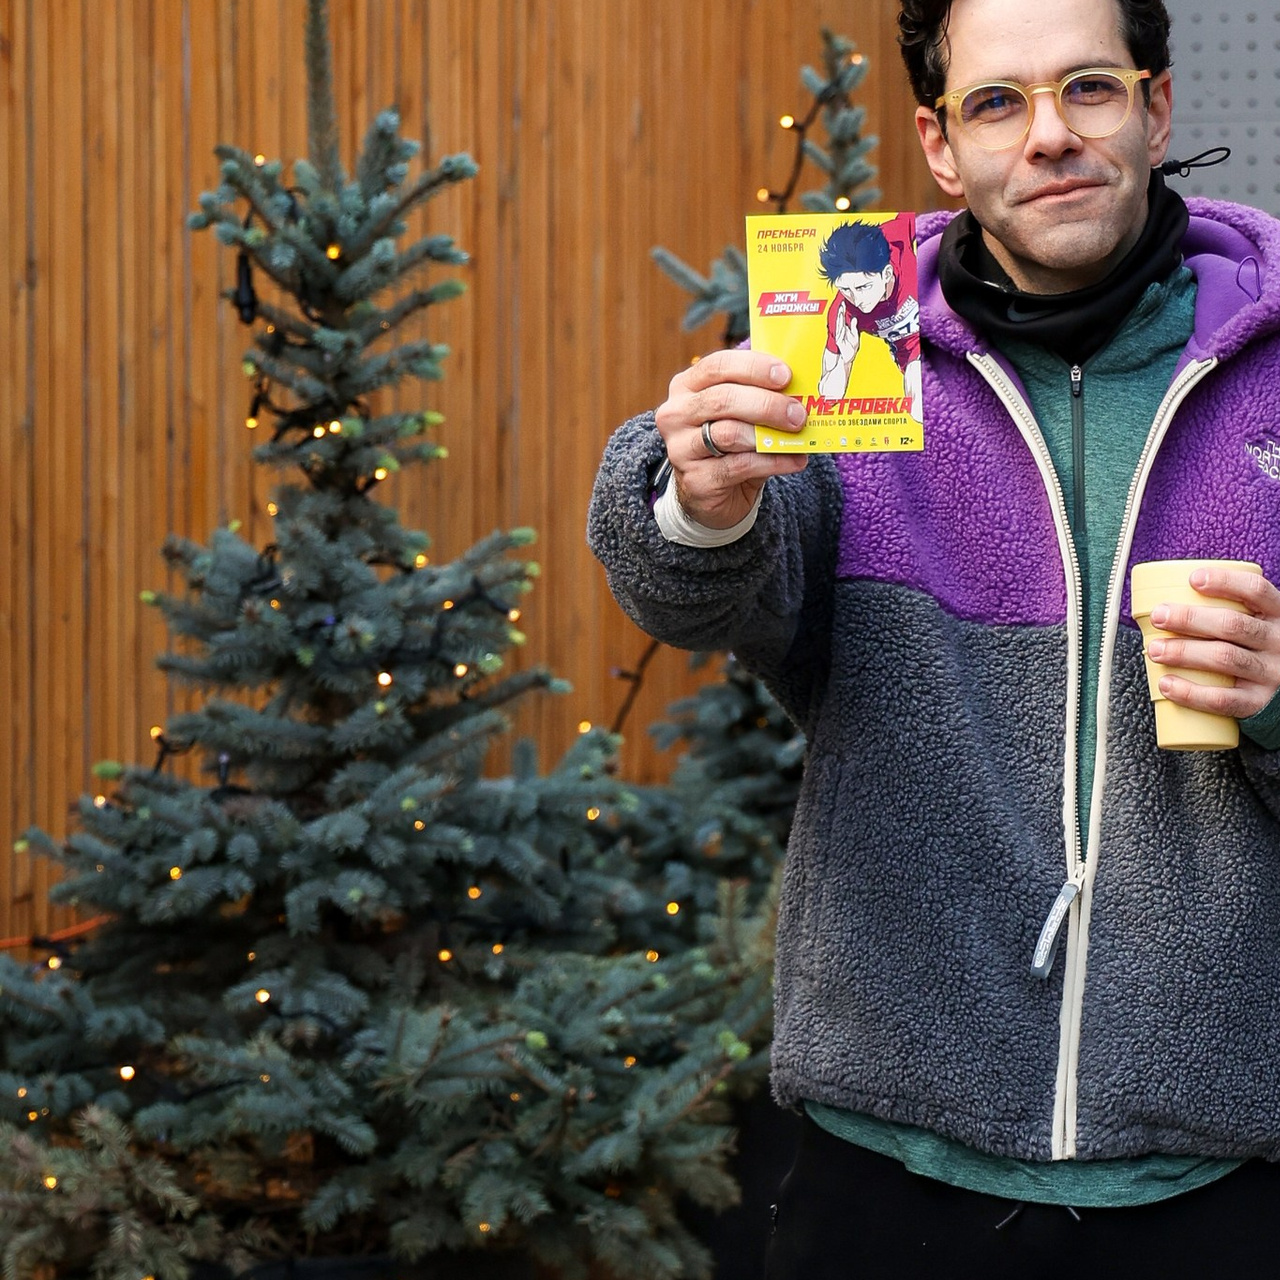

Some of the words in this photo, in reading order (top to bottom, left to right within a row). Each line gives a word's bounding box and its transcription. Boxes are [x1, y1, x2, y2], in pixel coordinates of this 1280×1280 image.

[757, 228, 817, 239] ПРЕМЬЕРА
[757, 244, 768, 253] 24
[771, 243, 804, 253] НОЯБРЯ
[774, 293, 798, 303] ЖГИ
[765, 303, 820, 315] ДОРОЖКУ!
[848, 418, 882, 426] ЗВЕЗДАМИ
[883, 417, 908, 425] СПОРТА
[900, 437, 915, 445] 12+
